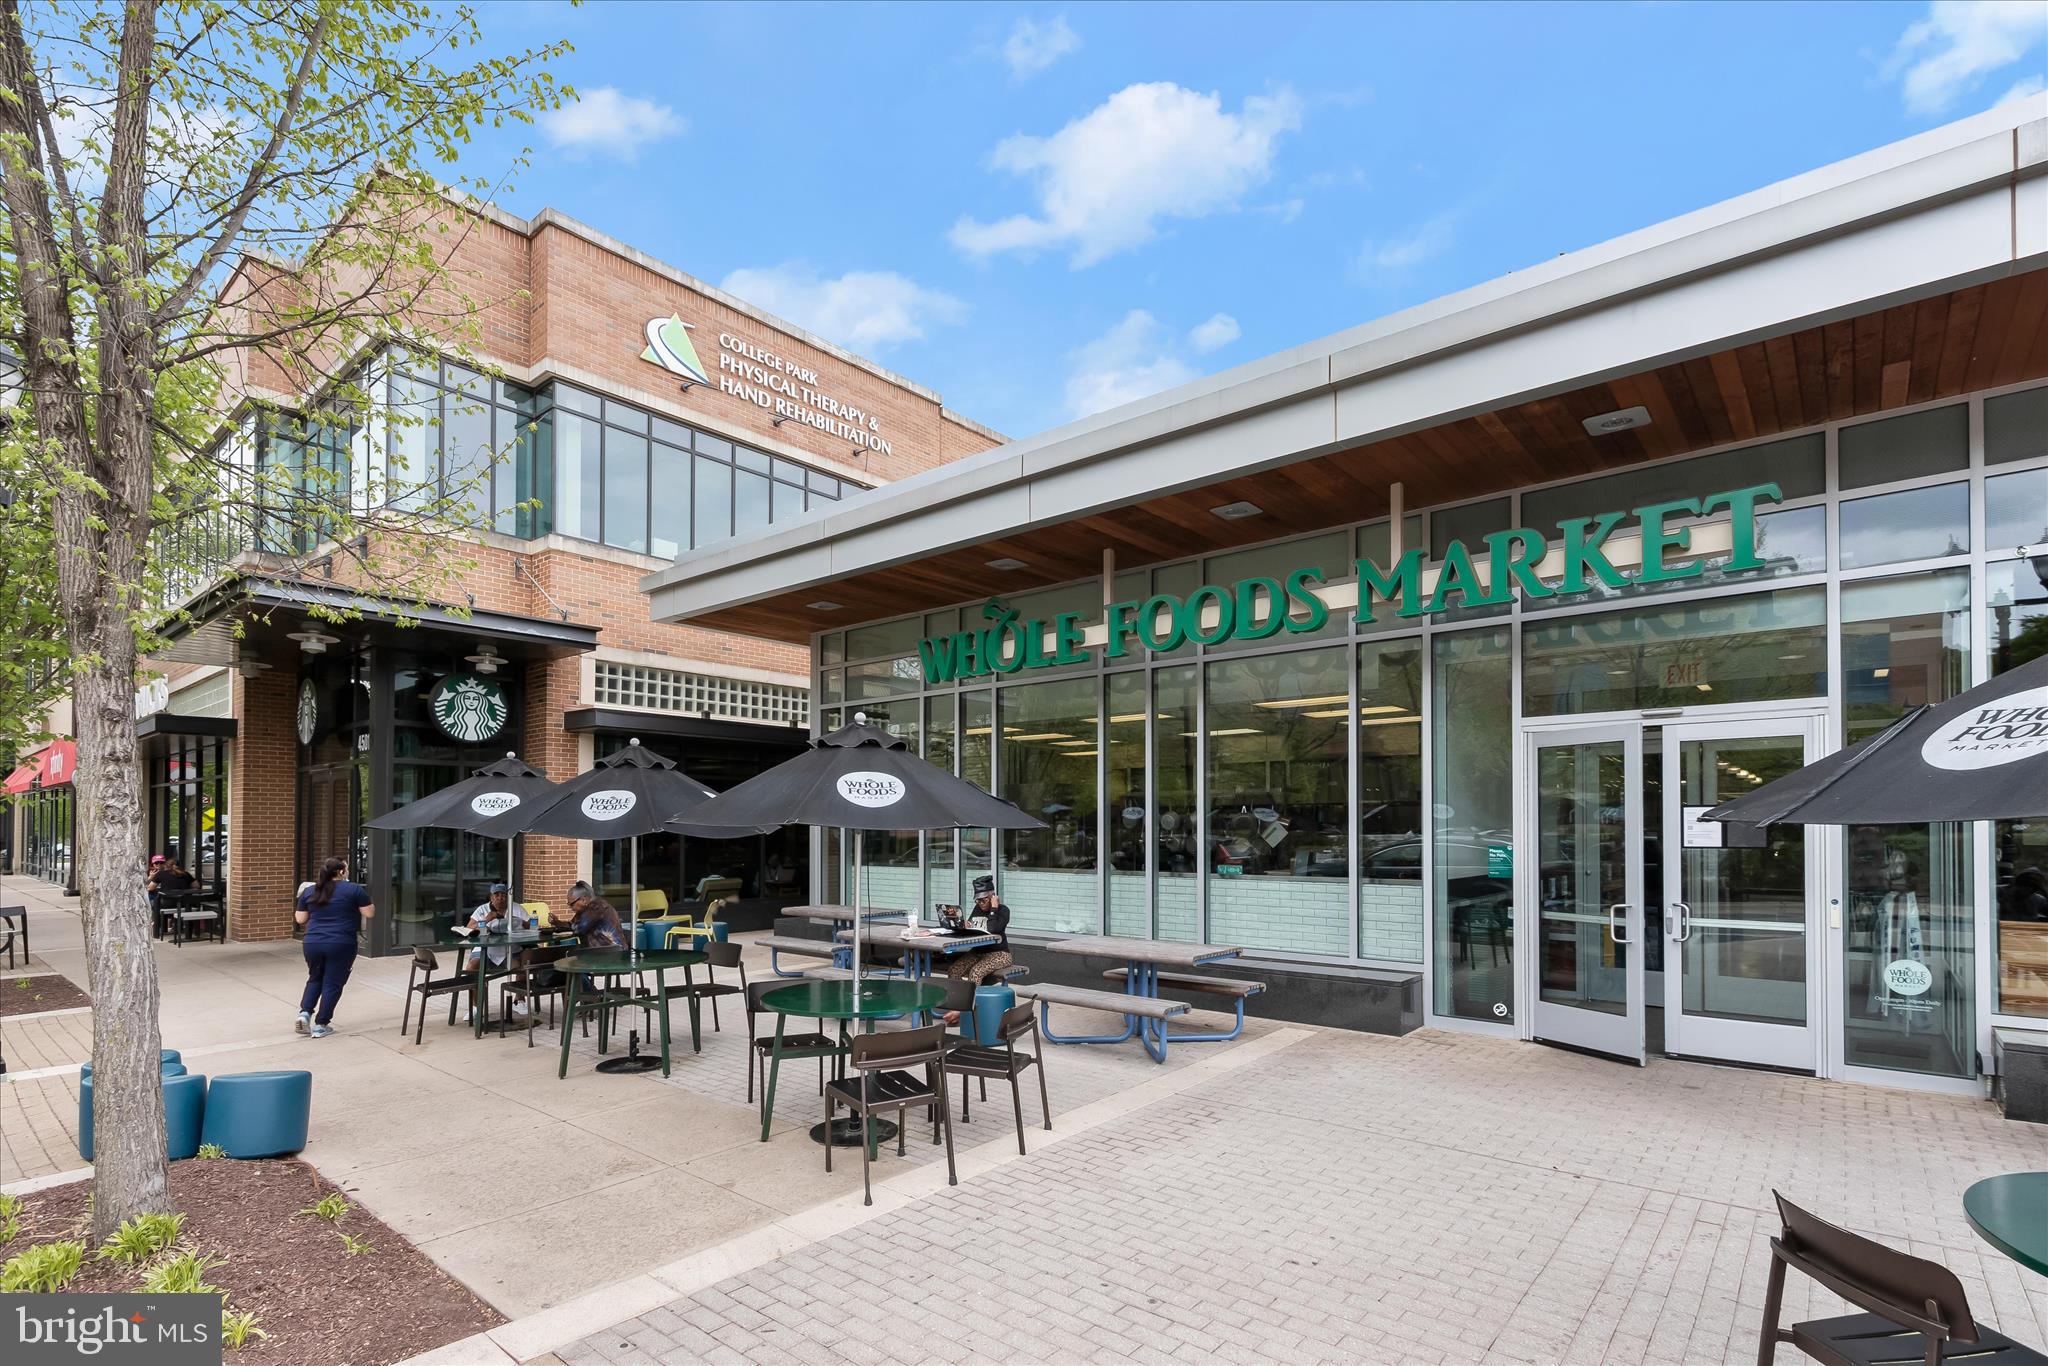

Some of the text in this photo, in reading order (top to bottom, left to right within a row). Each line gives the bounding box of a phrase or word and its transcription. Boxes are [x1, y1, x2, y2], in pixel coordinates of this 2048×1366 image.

[719, 333, 819, 387] COLLEGE PARK
[720, 353, 880, 433] PHYSICAL THERAPY &
[720, 374, 892, 456] HAND REHABILITATION
[917, 481, 1784, 684] WHOLE FOODS MARKET
[1666, 659, 1701, 687] EXIT
[843, 780, 897, 789] WHOLE
[847, 787, 897, 796] FOODS
[590, 797, 631, 805] WHOLE
[589, 803, 629, 811] FOODS
[1889, 969, 1926, 978] WHOLE
[1891, 976, 1926, 985] FOODS
